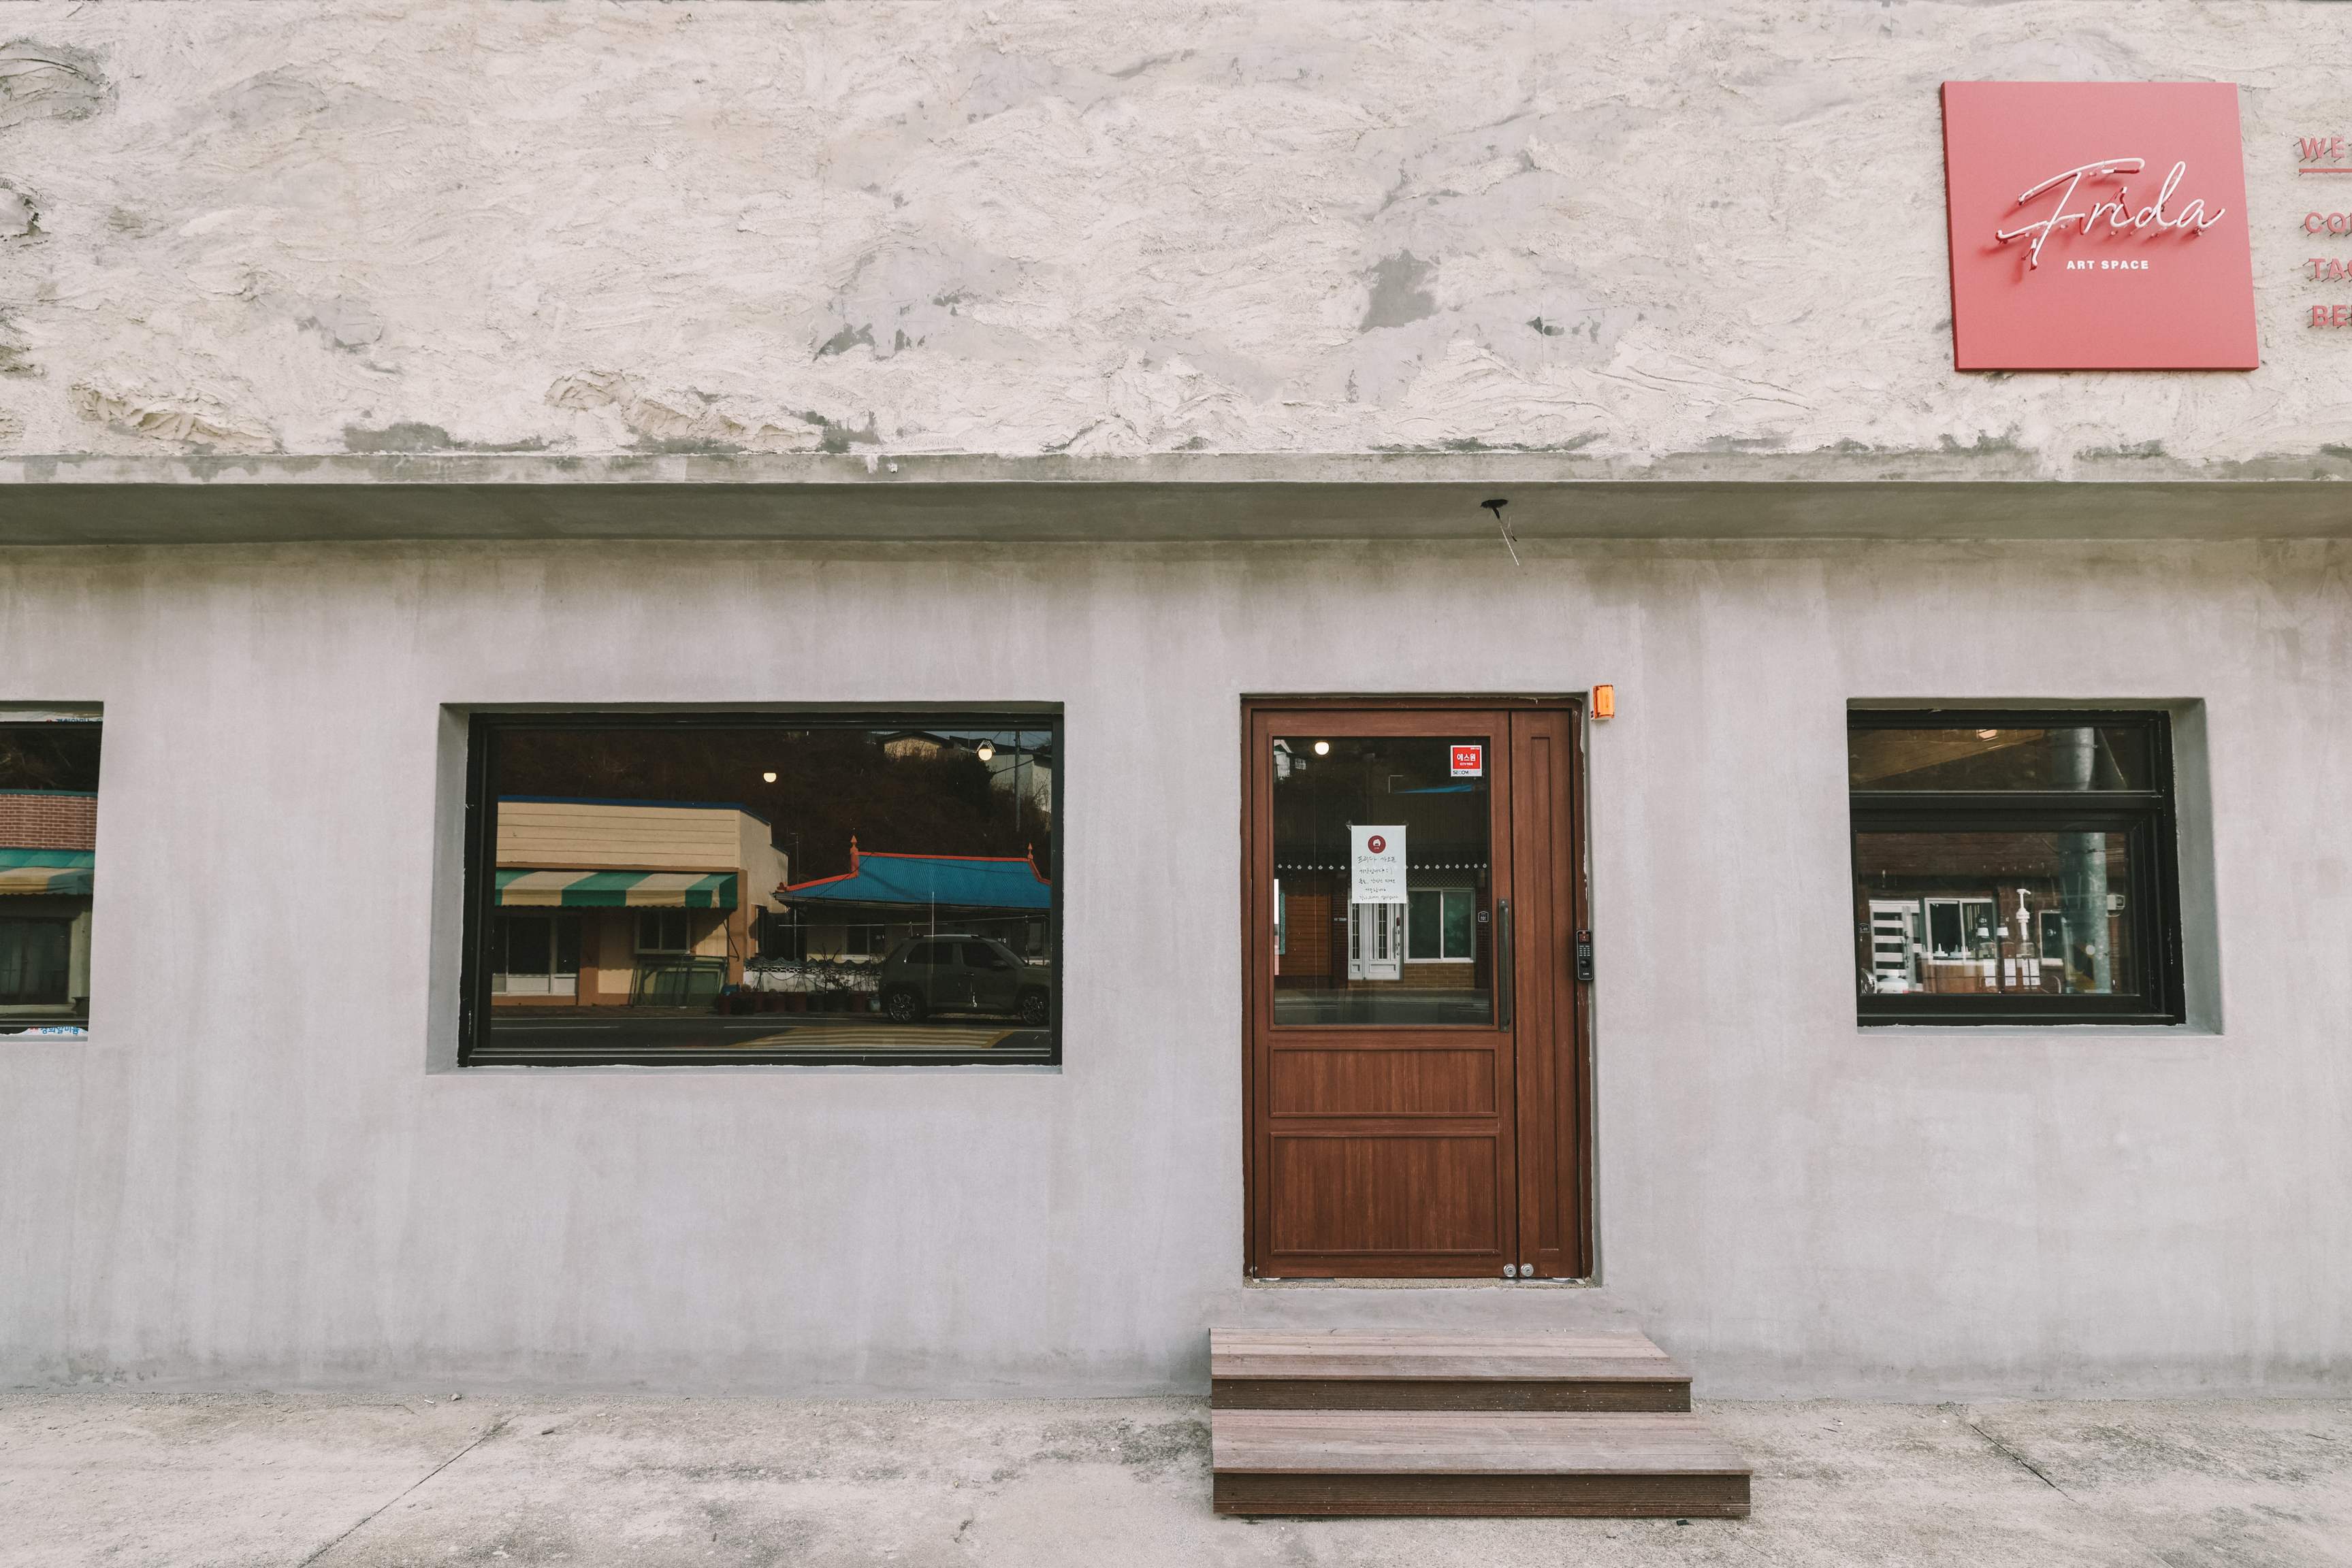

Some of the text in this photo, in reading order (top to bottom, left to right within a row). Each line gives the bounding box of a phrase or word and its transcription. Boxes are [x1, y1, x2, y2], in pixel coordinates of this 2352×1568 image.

[2300, 137, 2345, 159] WE
[1995, 157, 2225, 270] Frida
[2305, 212, 2352, 234] CO
[2066, 260, 2149, 270] ART SPACE
[2308, 258, 2352, 279] TA
[2313, 305, 2352, 327] BE
[1457, 753, 1476, 762] 에스원
[1357, 855, 1377, 864] 프리다
